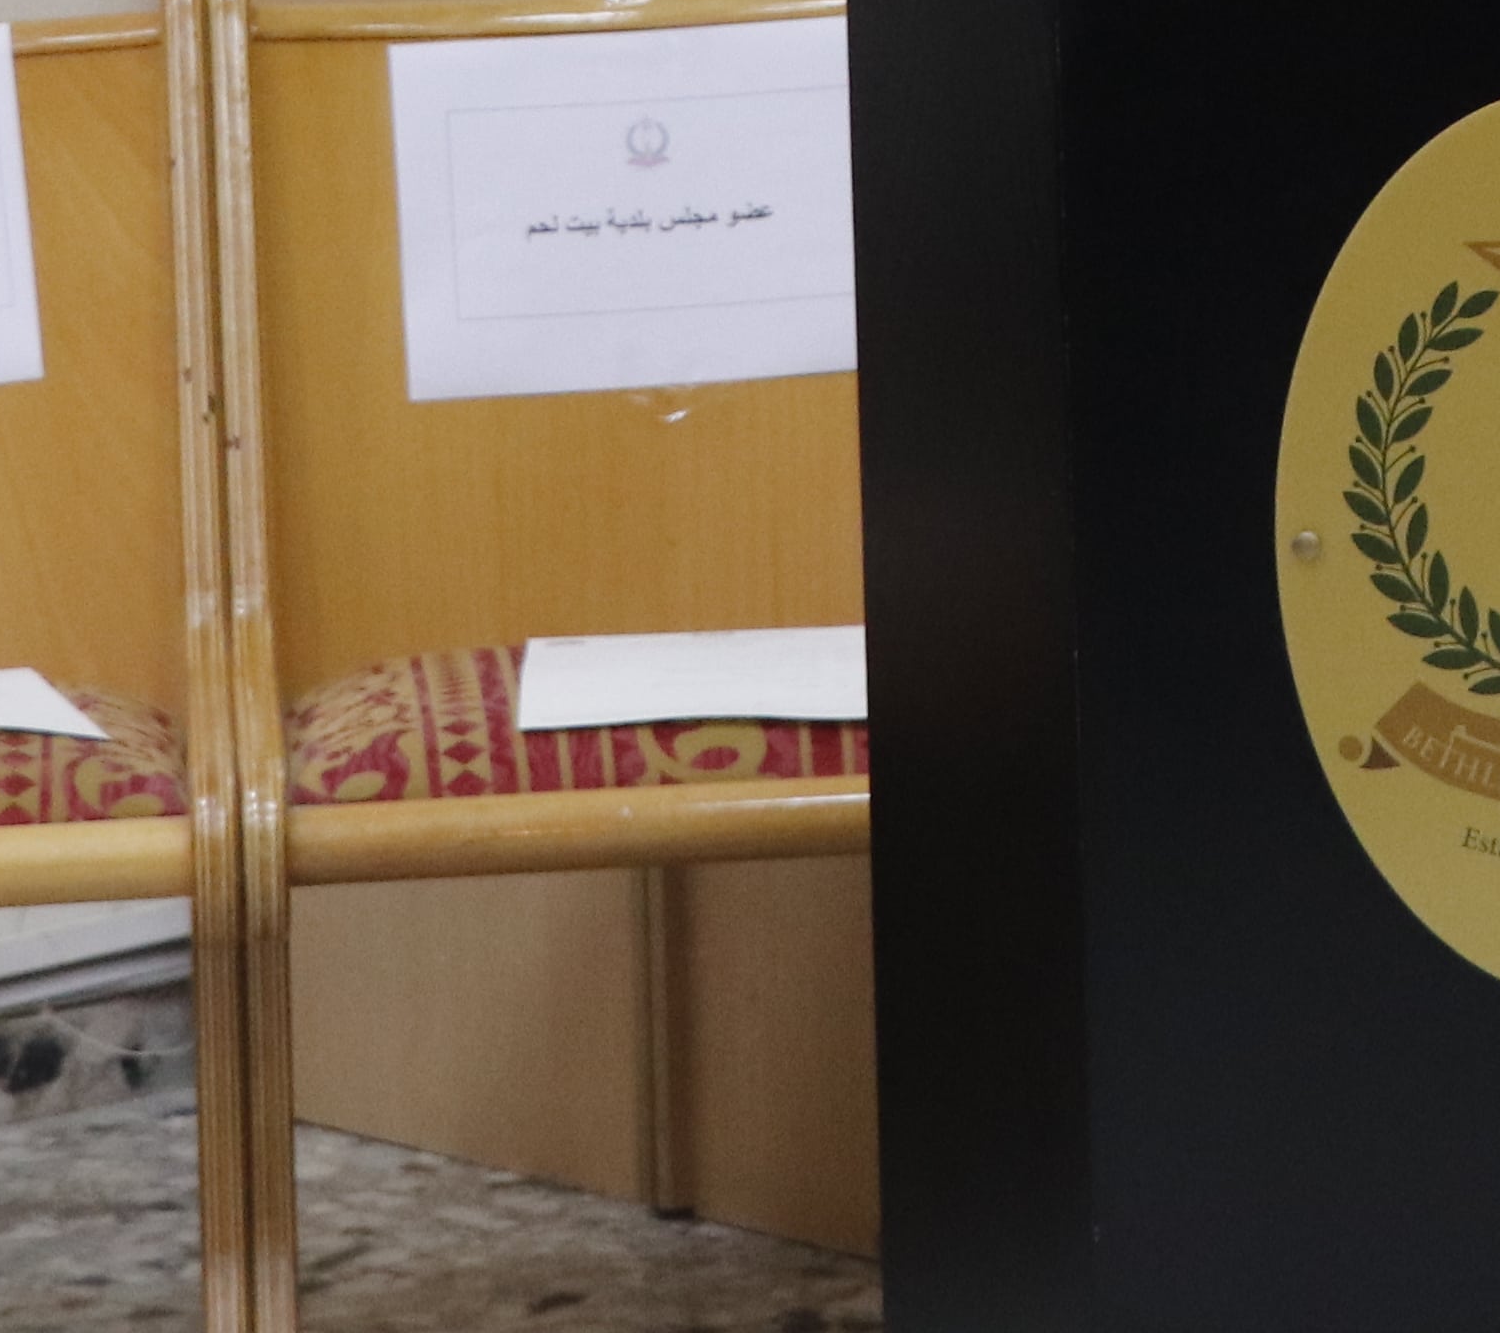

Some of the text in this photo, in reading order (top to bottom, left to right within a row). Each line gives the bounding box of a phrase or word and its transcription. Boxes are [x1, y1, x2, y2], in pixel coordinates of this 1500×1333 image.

[527, 202, 773, 241] عضو مجلس بلدية بيت لحم
